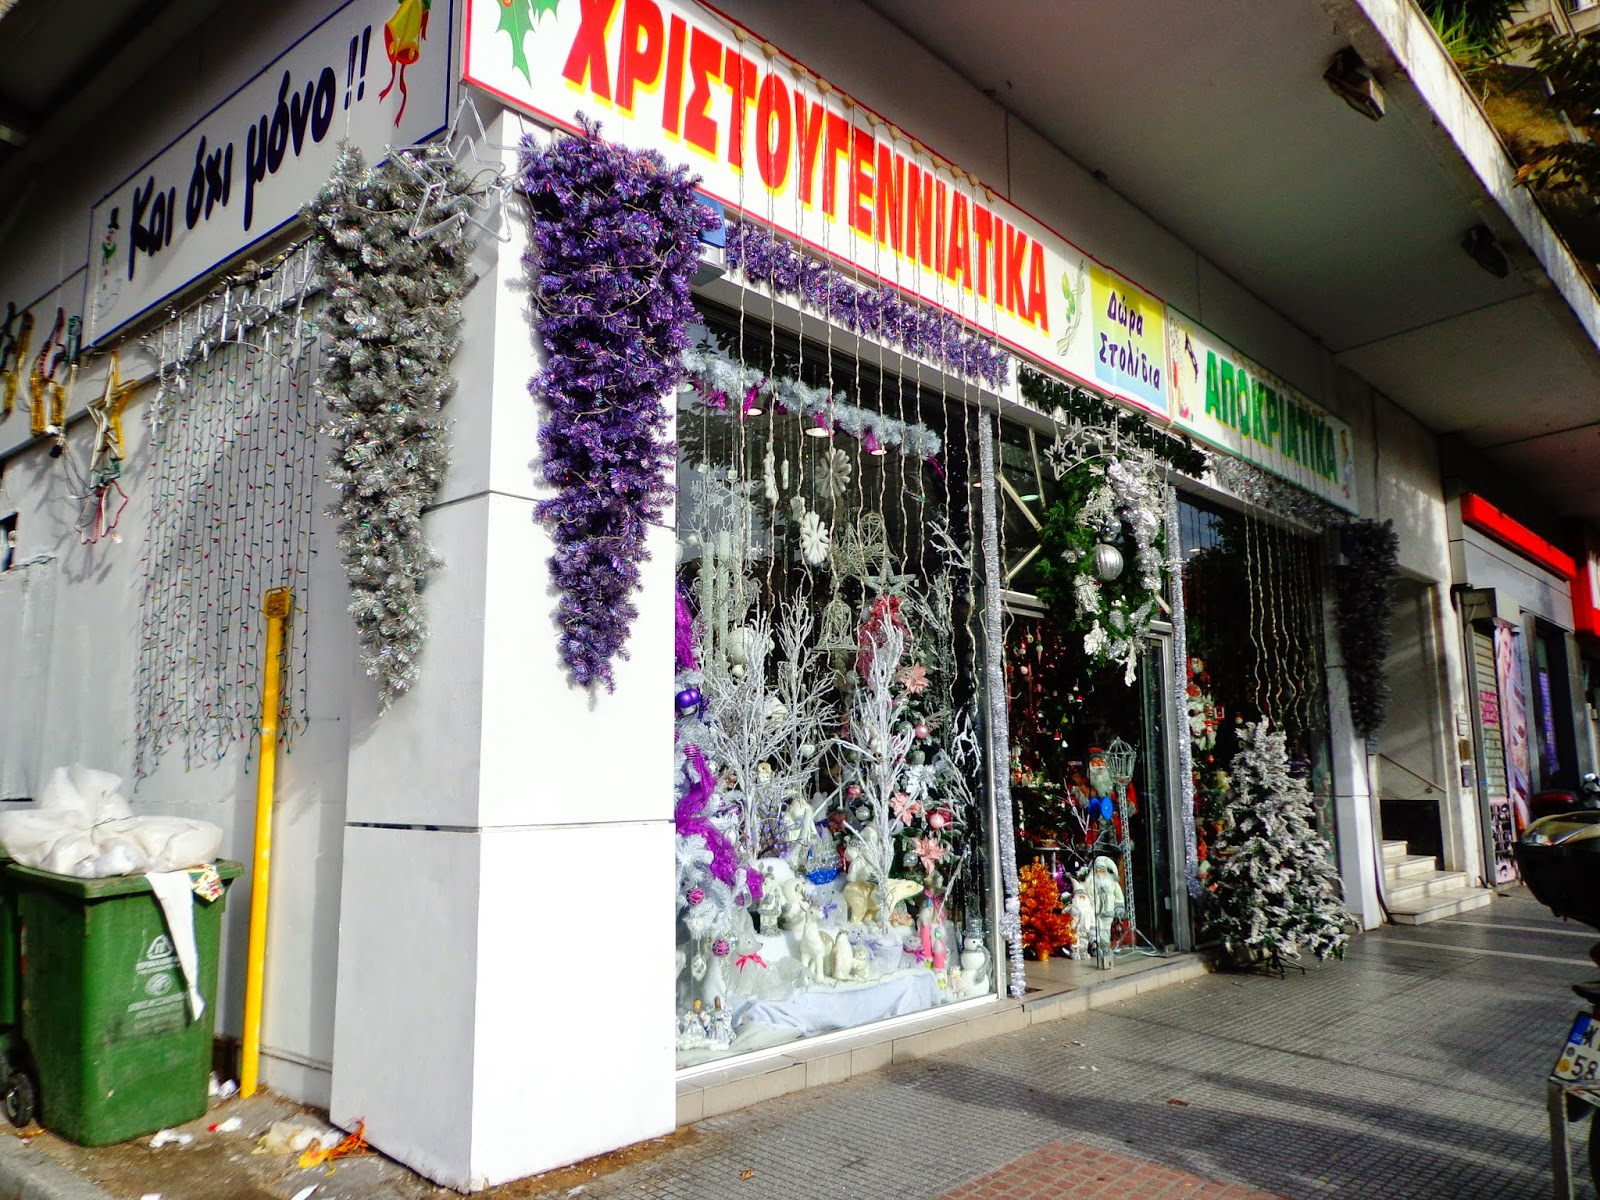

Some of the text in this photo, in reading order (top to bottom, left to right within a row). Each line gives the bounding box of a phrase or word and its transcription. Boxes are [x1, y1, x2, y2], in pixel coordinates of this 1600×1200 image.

[128, 175, 176, 282] Και
[186, 135, 233, 230] όχι
[243, 66, 336, 232] μόνο
[561, 0, 1049, 336] ΧΡΙΣΤΟΥΓΕΝΝΙΑΤΙΚΑ
[1099, 331, 1161, 391] Στολίδια
[1107, 290, 1144, 338] Δώρα
[1205, 349, 1339, 487] ΑΠΟΚΡΙΑΤΙΚΑ
